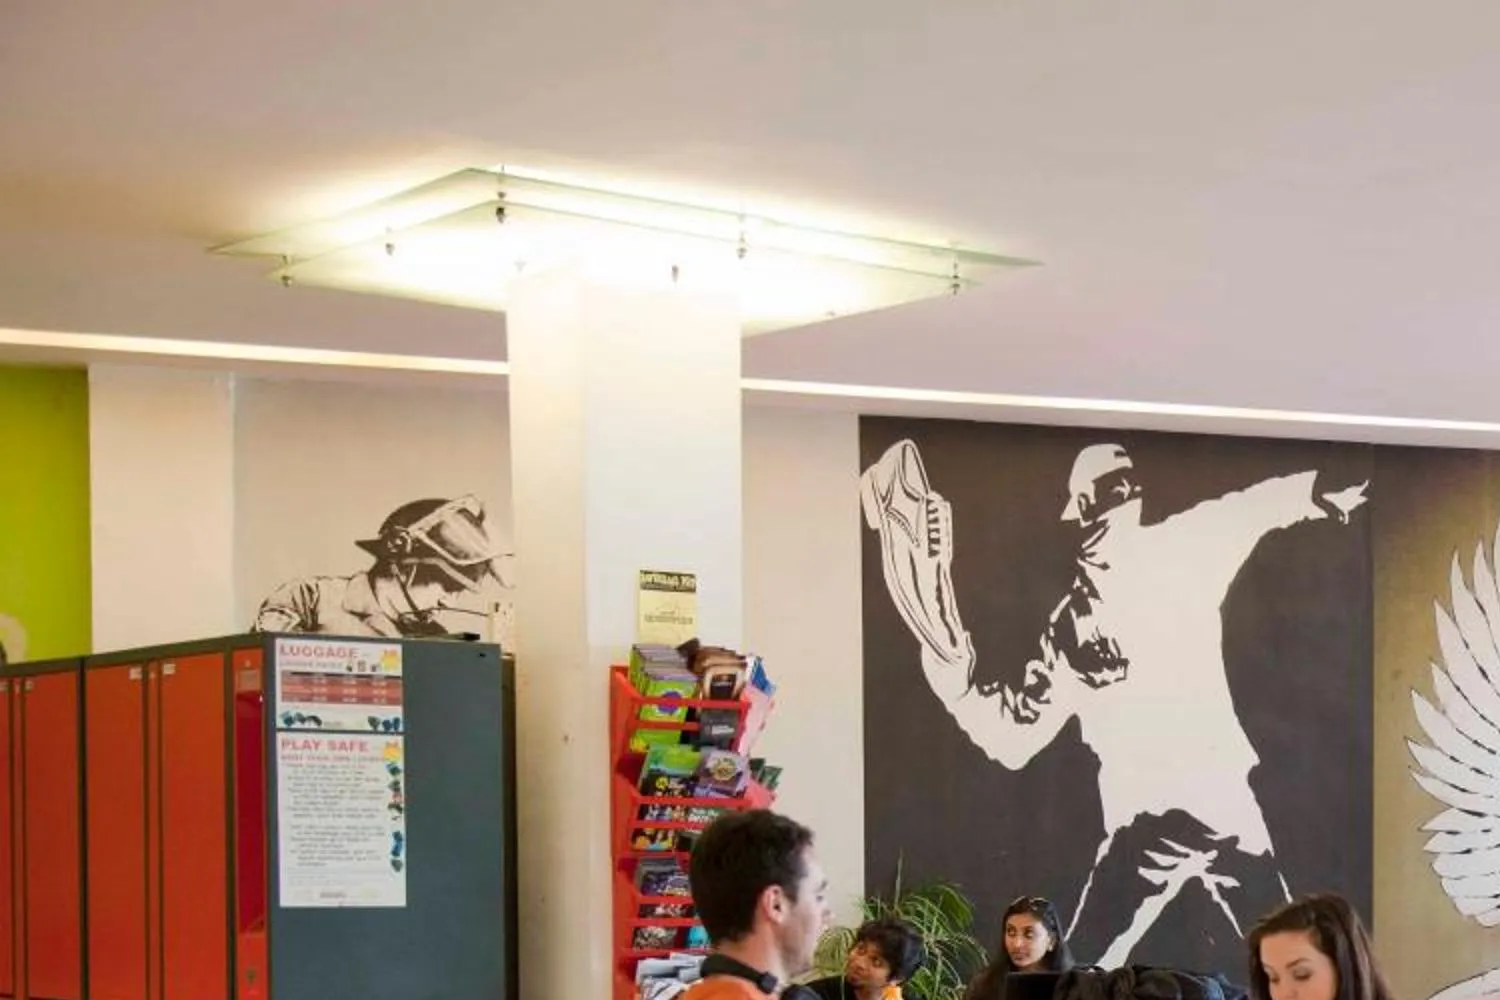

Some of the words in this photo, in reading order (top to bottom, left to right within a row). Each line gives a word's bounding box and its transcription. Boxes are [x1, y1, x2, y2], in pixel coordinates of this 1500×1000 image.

[280, 644, 360, 659] LUGGAGE
[281, 738, 320, 751] PLAY
[327, 740, 369, 753] SAFE
